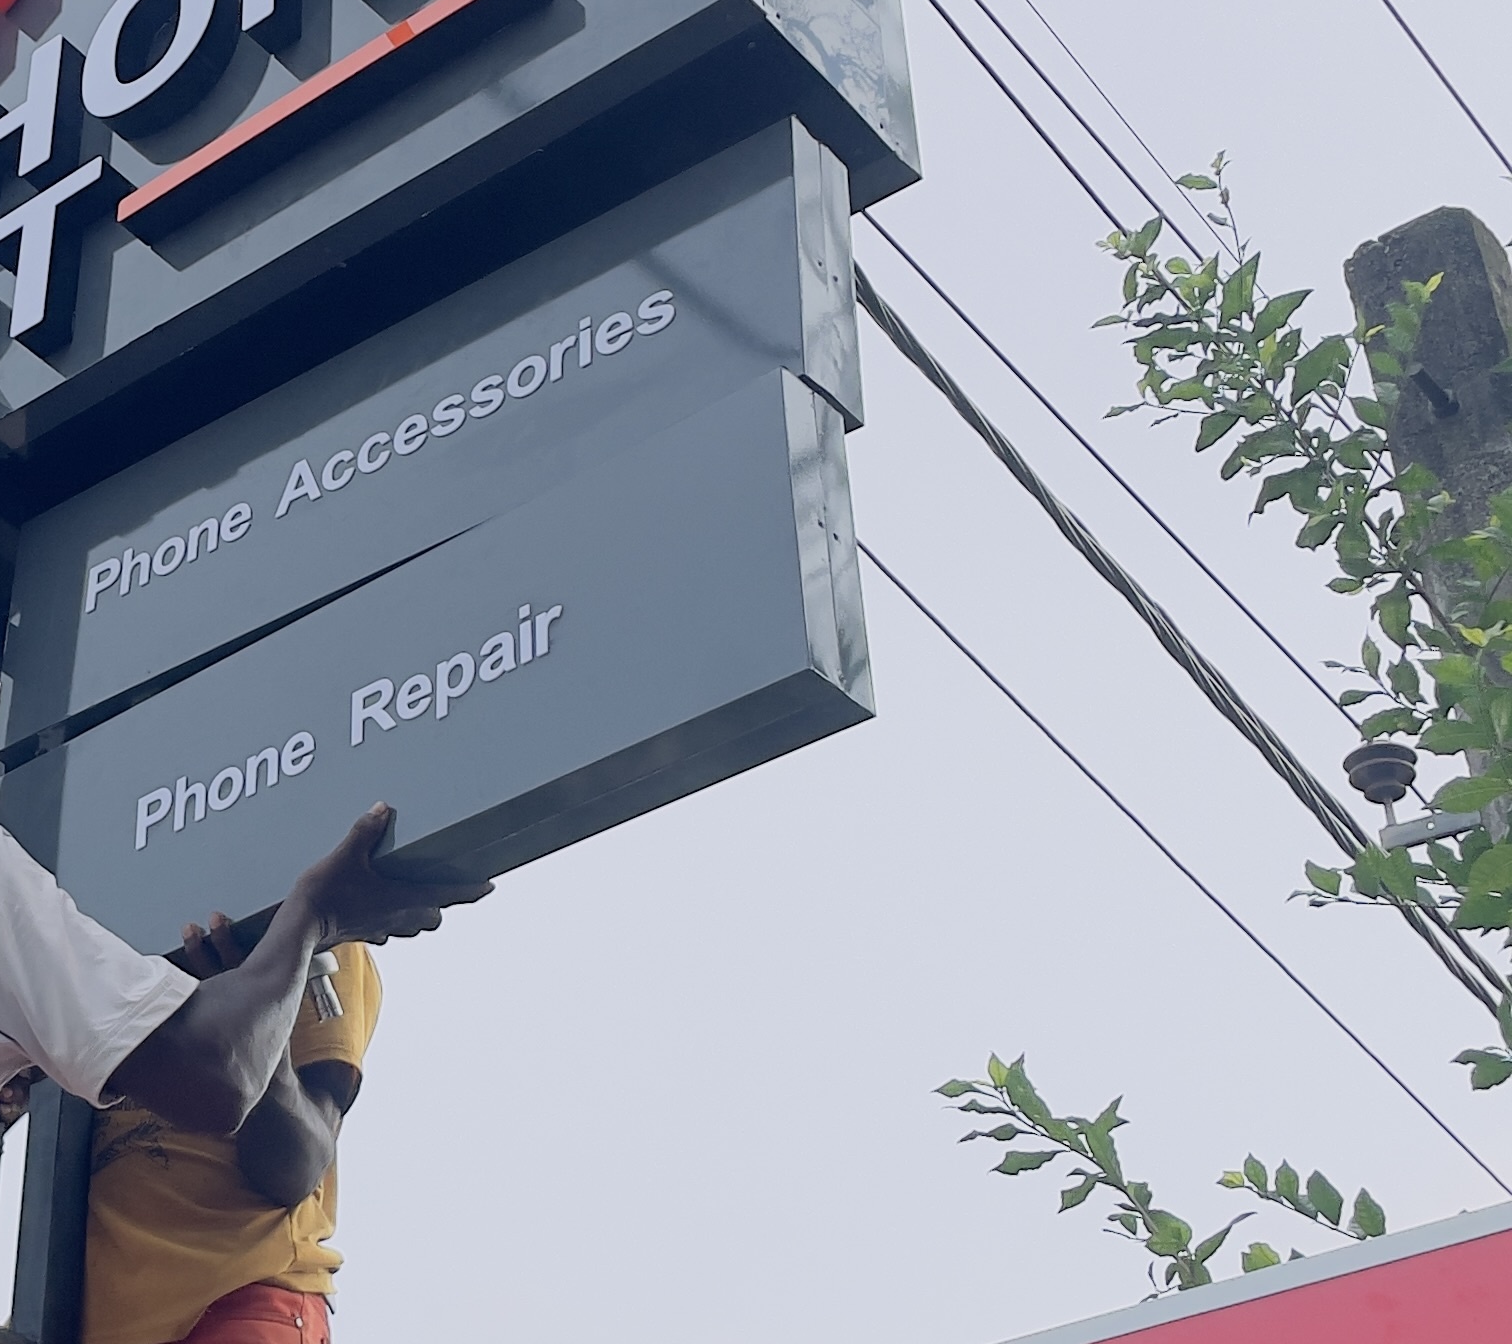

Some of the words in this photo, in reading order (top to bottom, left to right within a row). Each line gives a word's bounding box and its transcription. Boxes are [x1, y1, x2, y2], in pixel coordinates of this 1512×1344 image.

[84, 502, 253, 614] Phone
[274, 289, 676, 519] Accessories
[134, 730, 316, 851] Phone
[350, 602, 563, 747] Repair
